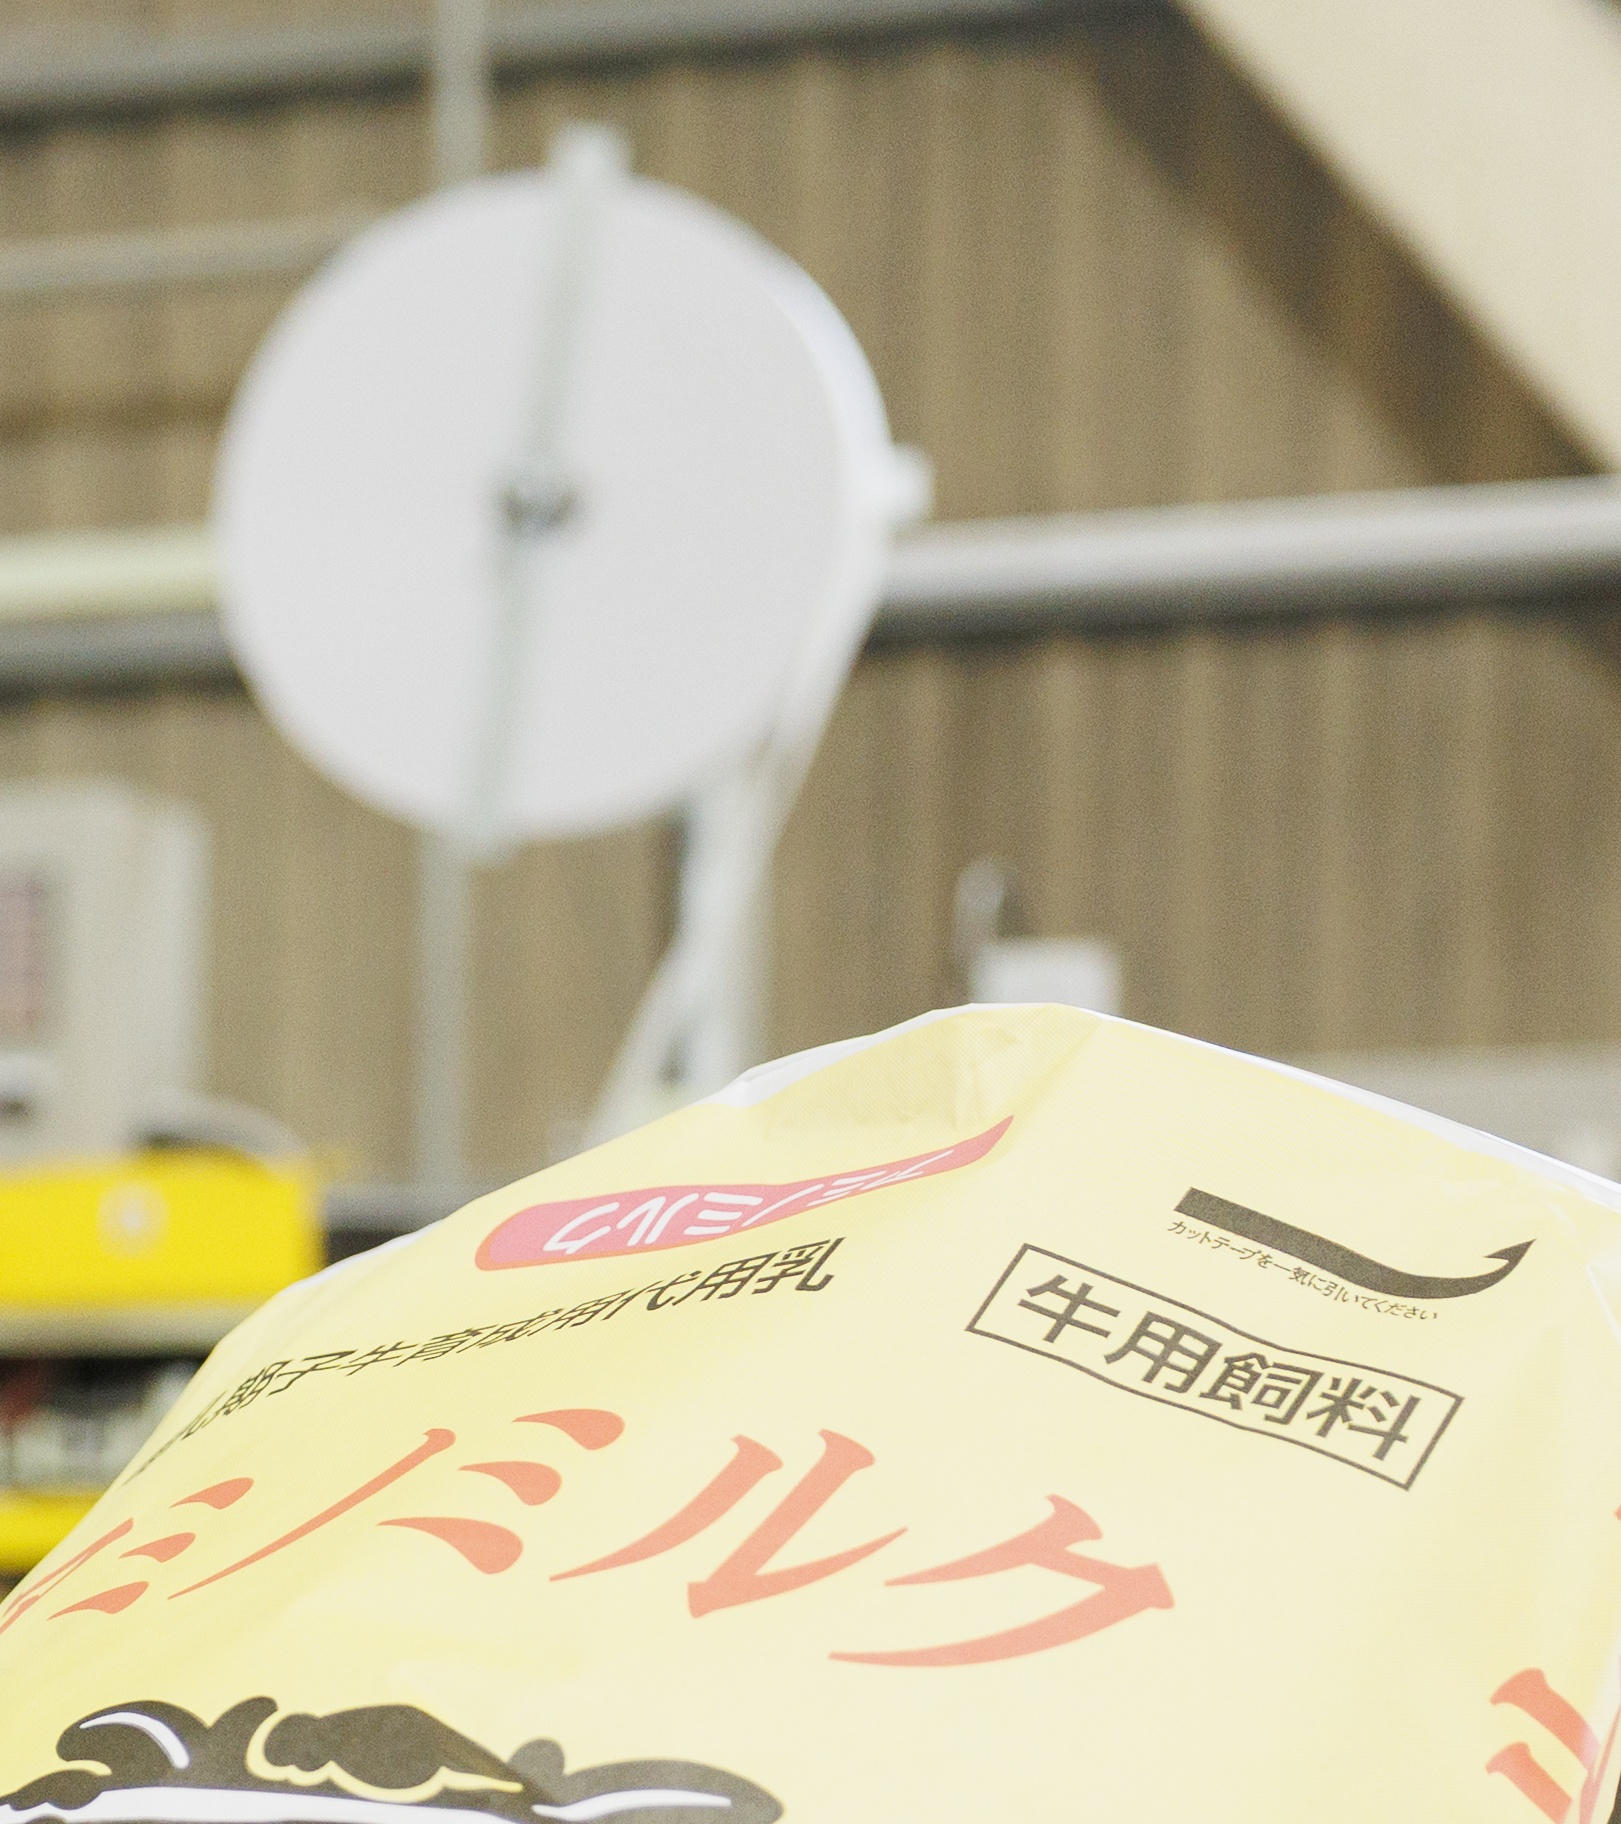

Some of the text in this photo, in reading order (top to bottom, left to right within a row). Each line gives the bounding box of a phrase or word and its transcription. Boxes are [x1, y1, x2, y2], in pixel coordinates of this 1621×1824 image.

[543, 1149, 954, 1256] アミノミルク
[1167, 1219, 1438, 1320] カットテープを一気に引いてください
[123, 1235, 846, 1487] 期子牛育成用代用乳
[1016, 1273, 1423, 1463] 牛用飼料
